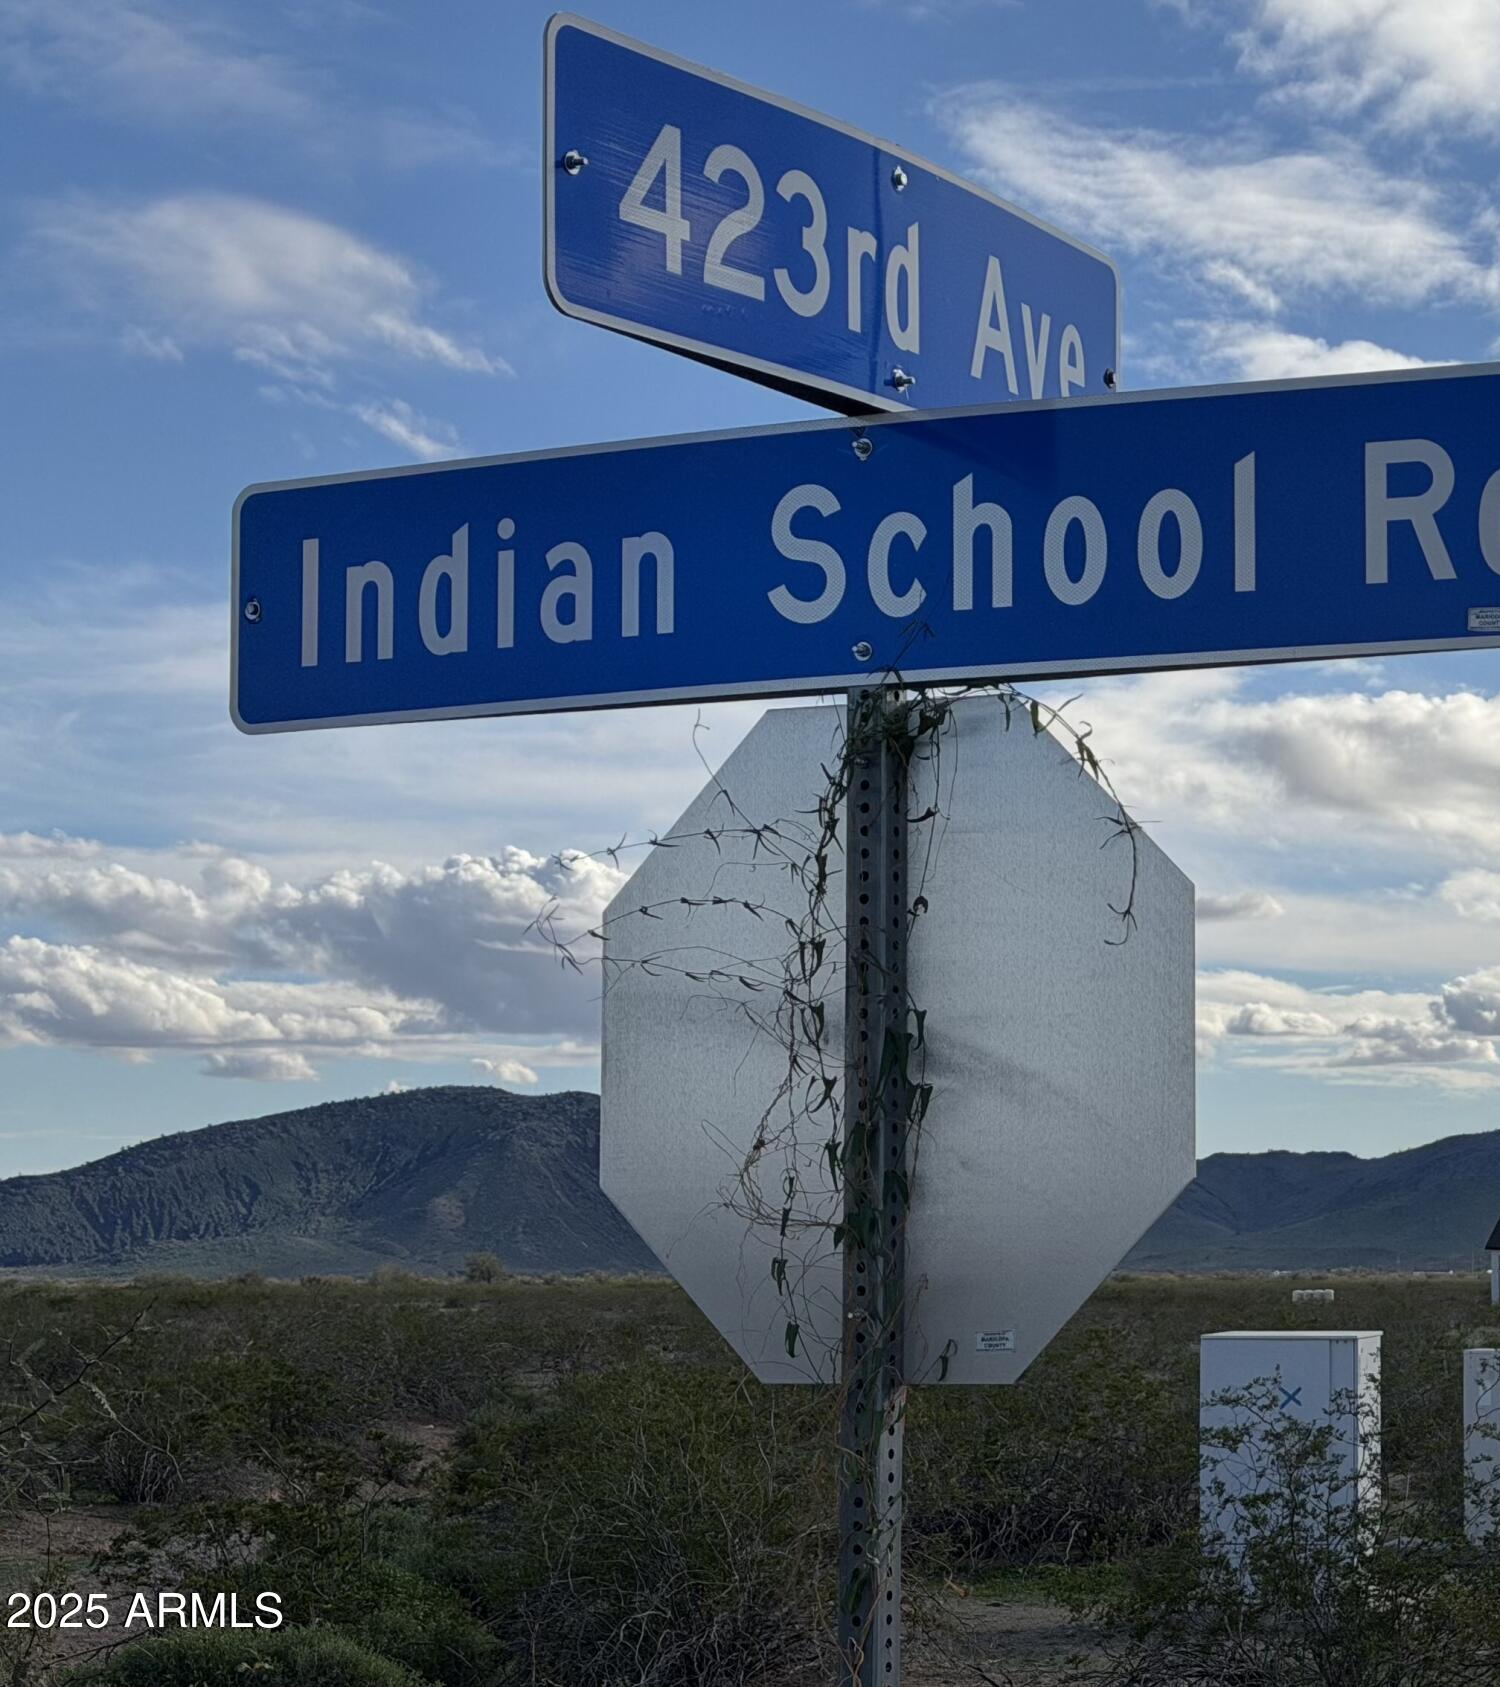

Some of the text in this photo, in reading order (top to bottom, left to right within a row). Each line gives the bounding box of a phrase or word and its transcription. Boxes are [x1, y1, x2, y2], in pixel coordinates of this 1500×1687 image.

[618, 123, 1087, 399] 423rd Ave
[300, 516, 675, 668] Indian
[766, 450, 1257, 625] School
